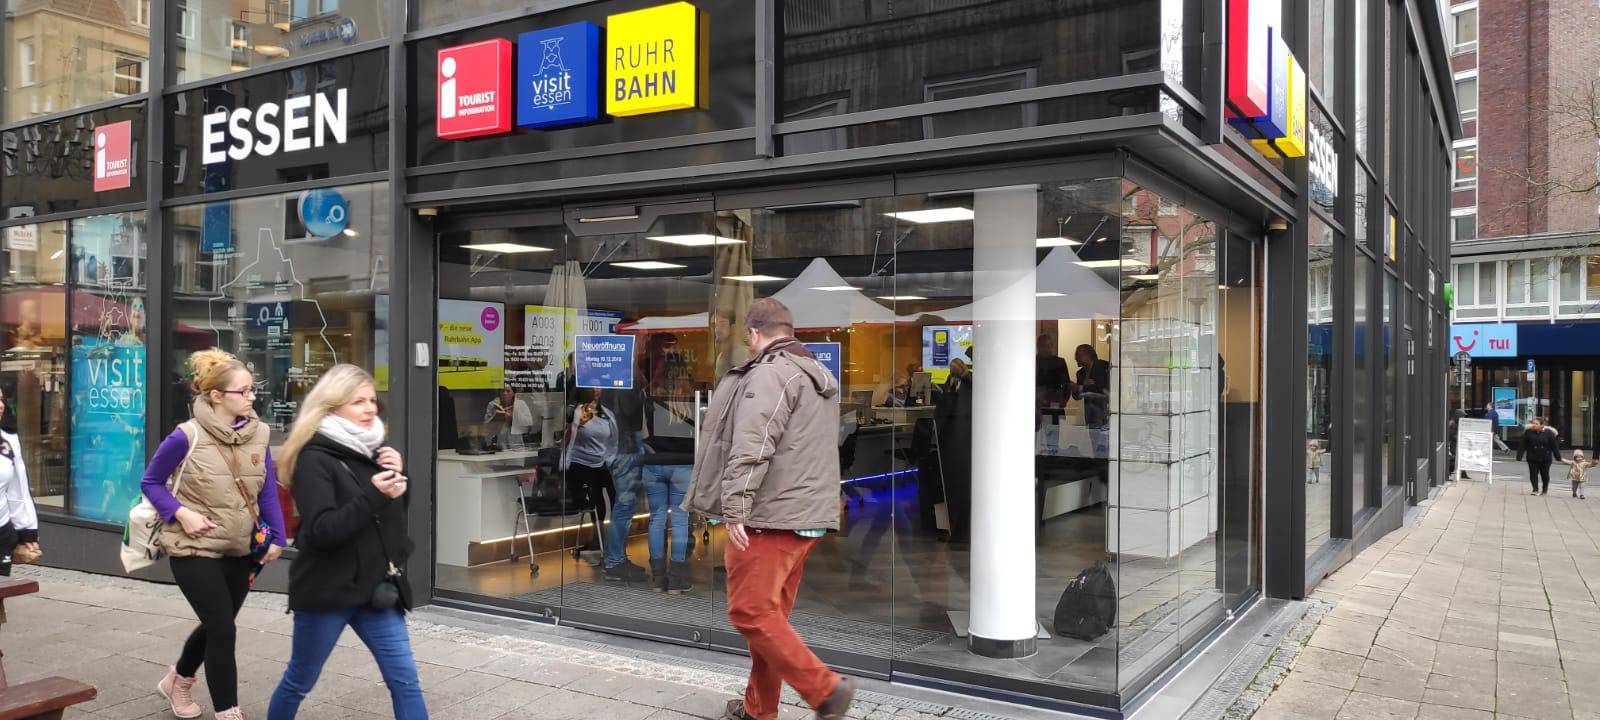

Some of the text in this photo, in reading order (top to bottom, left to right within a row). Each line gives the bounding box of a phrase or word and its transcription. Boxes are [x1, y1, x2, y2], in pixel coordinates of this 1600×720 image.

[615, 38, 675, 71] RUHR
[532, 71, 571, 94] visit
[615, 69, 676, 101] BAHN
[458, 90, 496, 107] TOURIST
[533, 89, 571, 106] essen
[458, 104, 495, 117] INFORMATION
[202, 88, 347, 165] ESSEN
[106, 158, 128, 170] TOURIST
[531, 316, 555, 329] A003
[582, 319, 604, 332] H001
[581, 341, 626, 351] Neueröffnung
[1488, 339, 1510, 350] TUI
[87, 349, 143, 387] visit
[89, 387, 143, 409] essen
